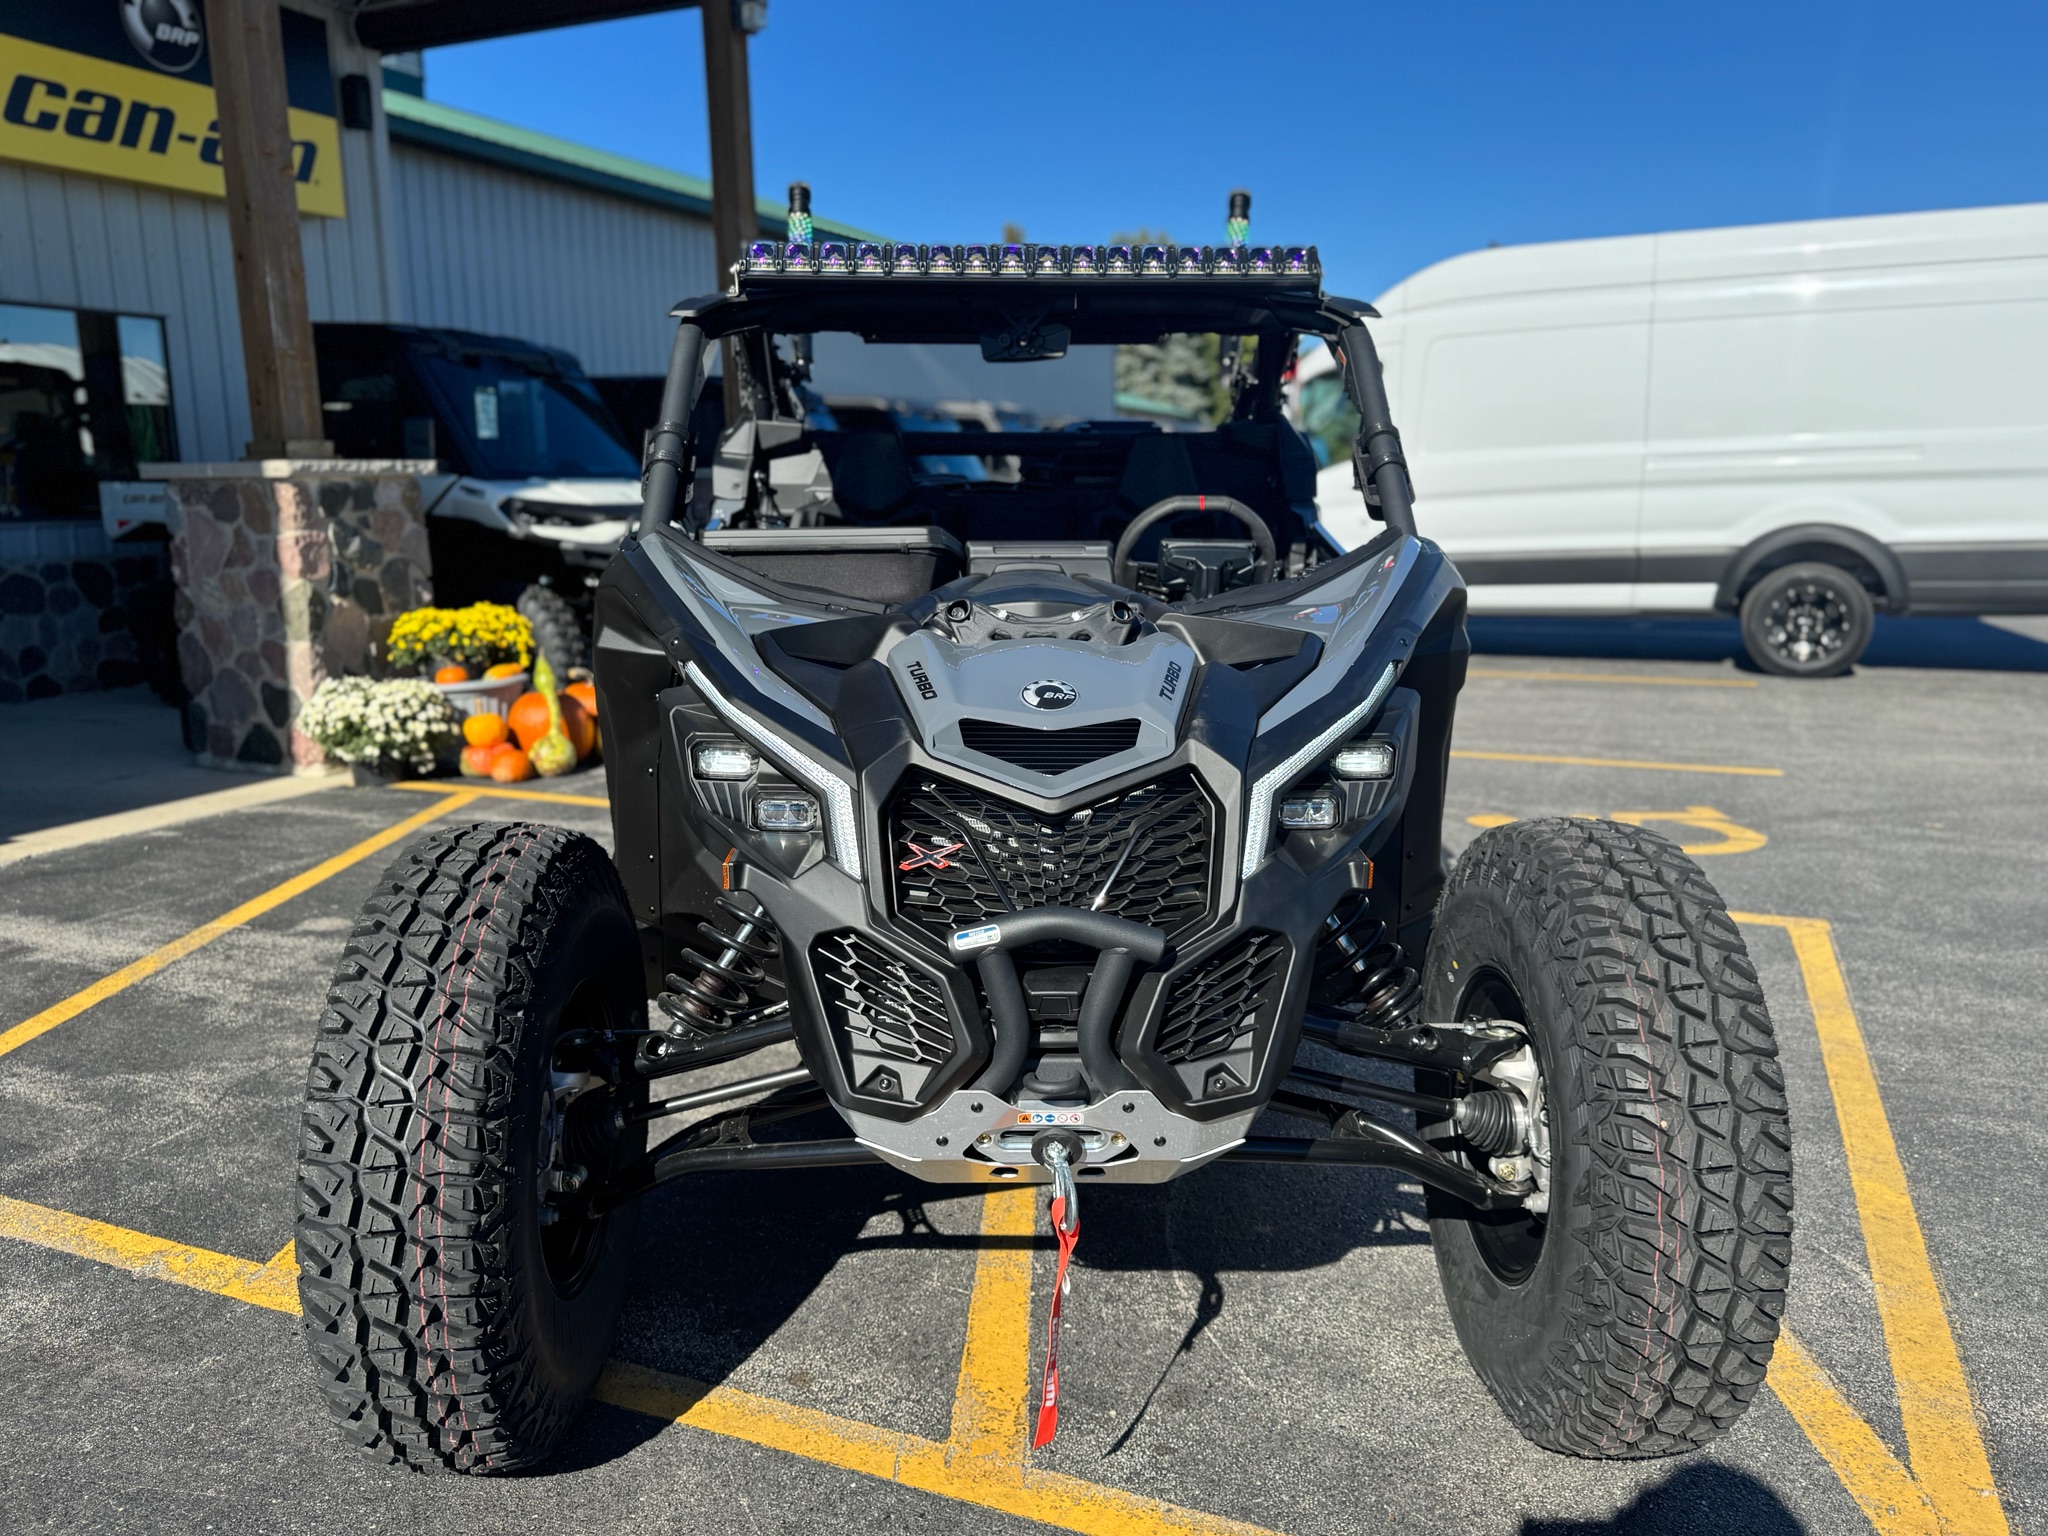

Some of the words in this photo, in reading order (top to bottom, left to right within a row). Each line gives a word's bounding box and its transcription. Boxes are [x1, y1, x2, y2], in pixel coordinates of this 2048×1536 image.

[155, 22, 200, 47] BRP
[906, 660, 938, 701] TURBO
[1043, 691, 1076, 700] BRP
[1158, 660, 1182, 701] TURBO
